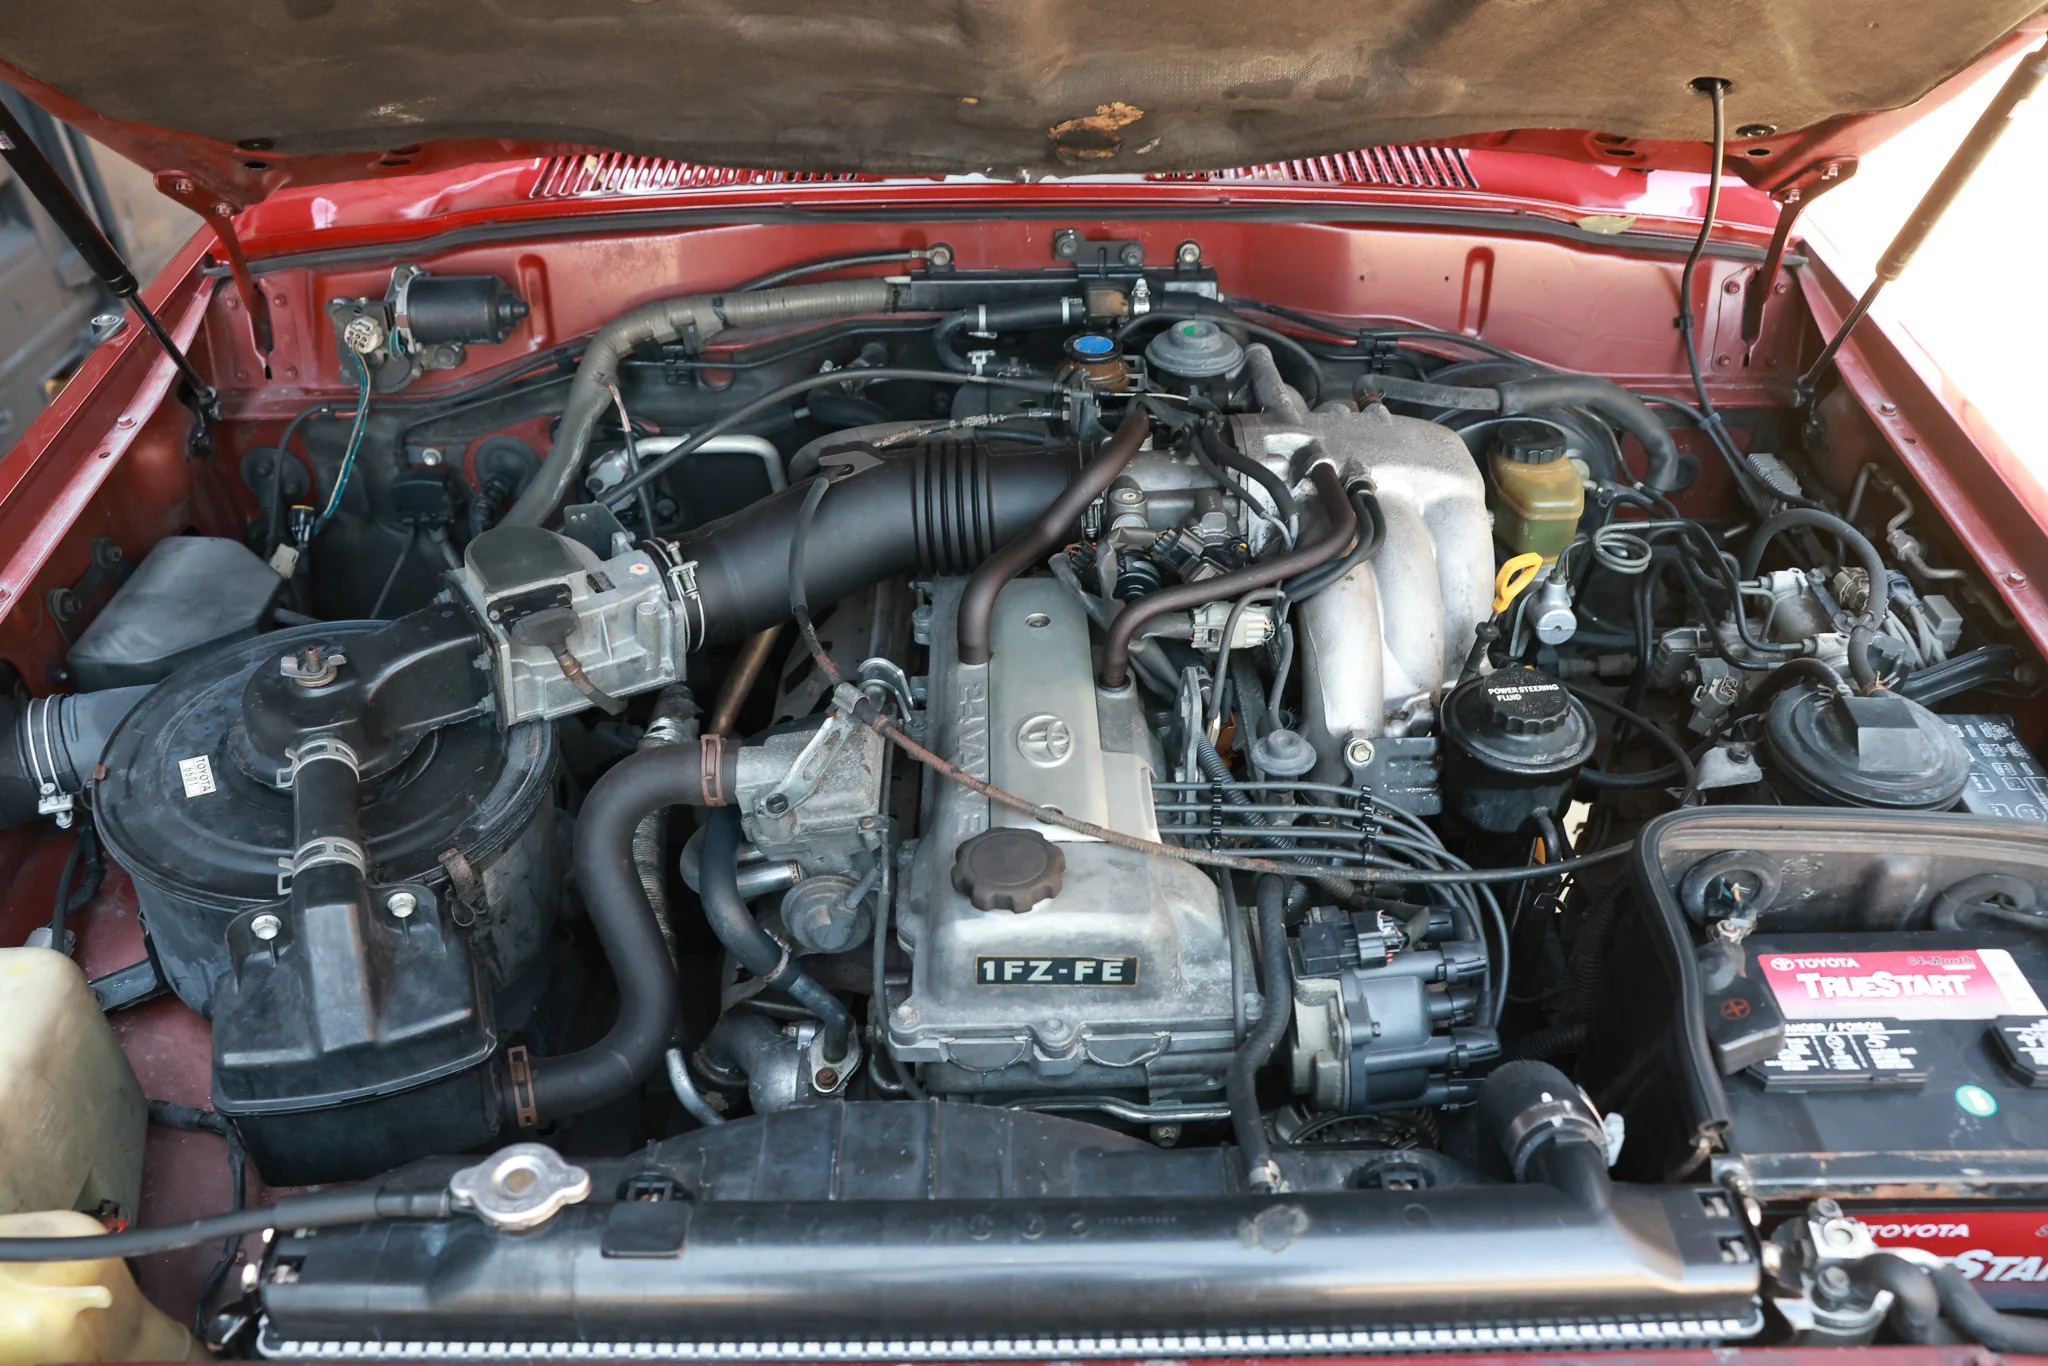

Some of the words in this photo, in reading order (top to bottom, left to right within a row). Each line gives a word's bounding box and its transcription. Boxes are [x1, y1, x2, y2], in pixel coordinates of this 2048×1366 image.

[1488, 687, 1518, 695] POWER
[1518, 684, 1559, 693] STEERING
[184, 767, 198, 785] 6601
[196, 758, 211, 792] TOYOTA
[983, 961, 1123, 981] 1FZ-FE
[1794, 958, 1860, 969] TOYOTA
[1796, 971, 1968, 999] TRUESTART
[1868, 1224, 1969, 1238] TOYOTA
